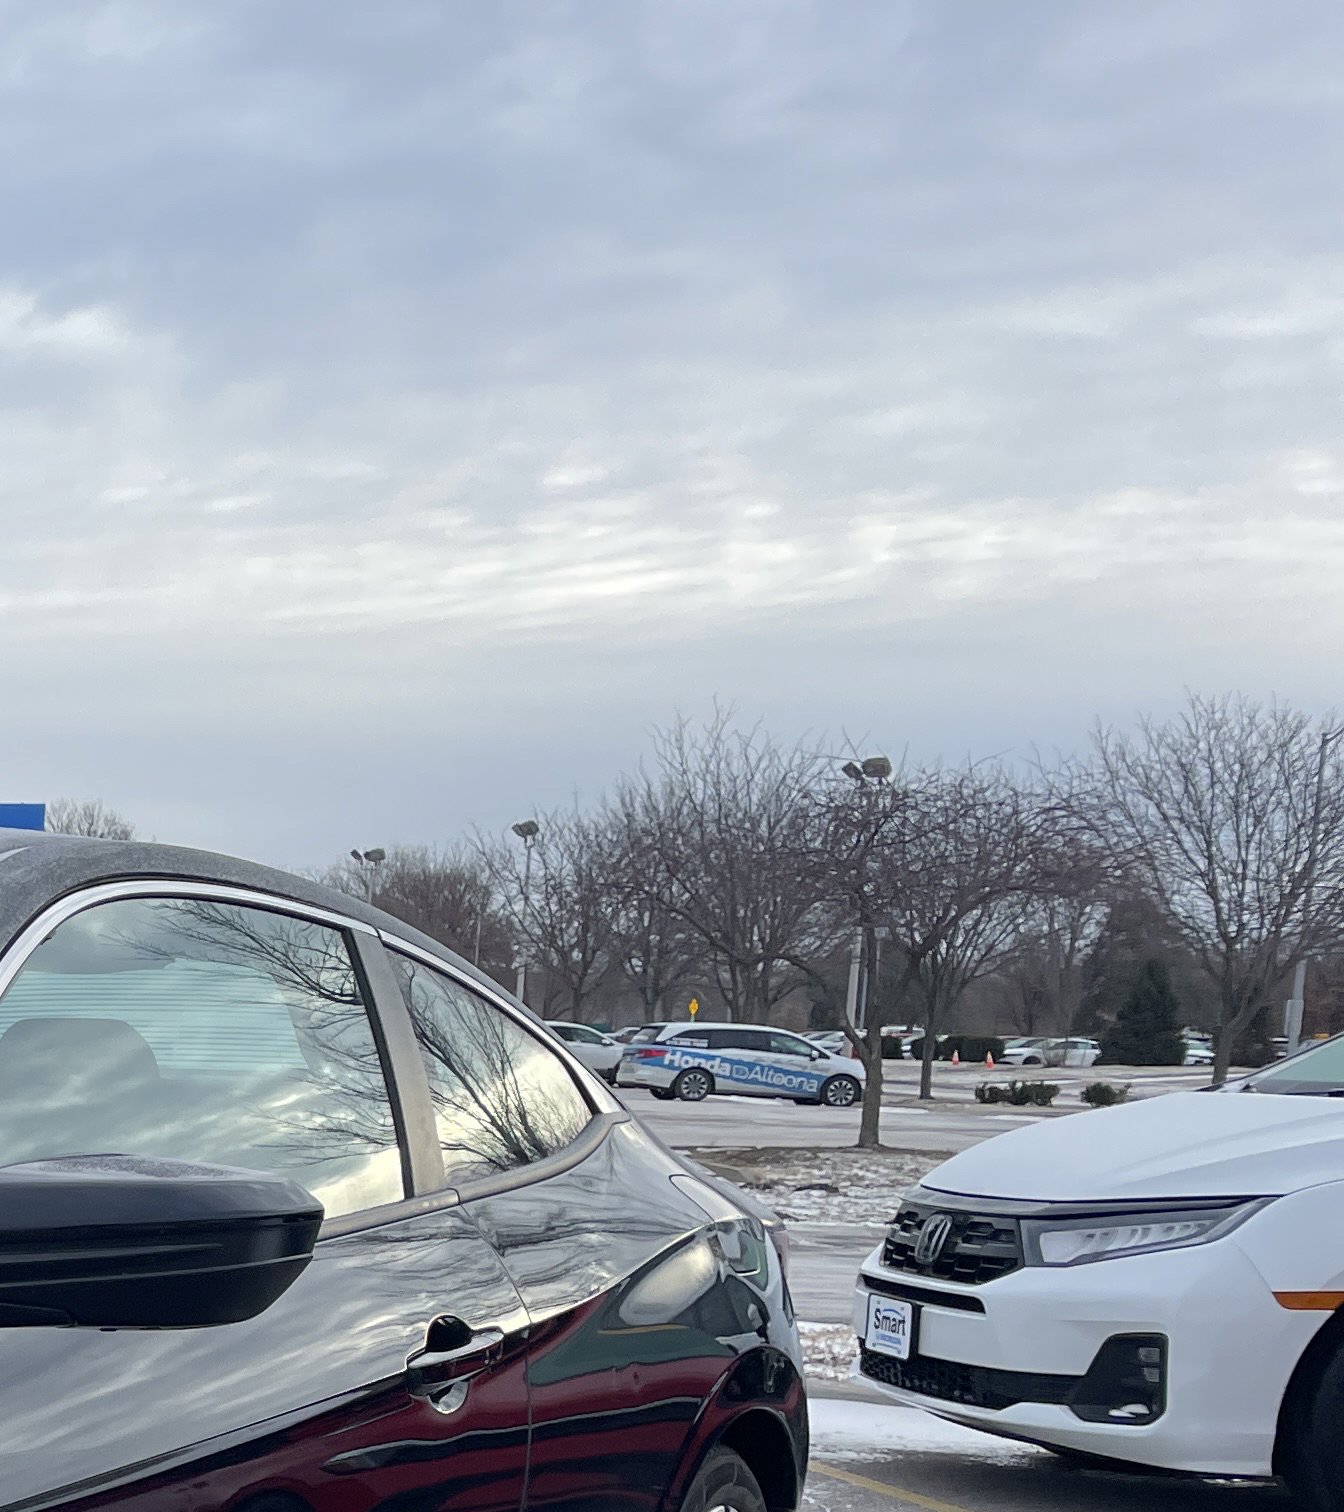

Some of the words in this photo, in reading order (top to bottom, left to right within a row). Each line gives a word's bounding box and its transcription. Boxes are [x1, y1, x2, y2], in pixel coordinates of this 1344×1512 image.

[664, 1051, 731, 1076] Honda
[748, 1065, 818, 1092] Altoona
[874, 1308, 905, 1336] Smart
